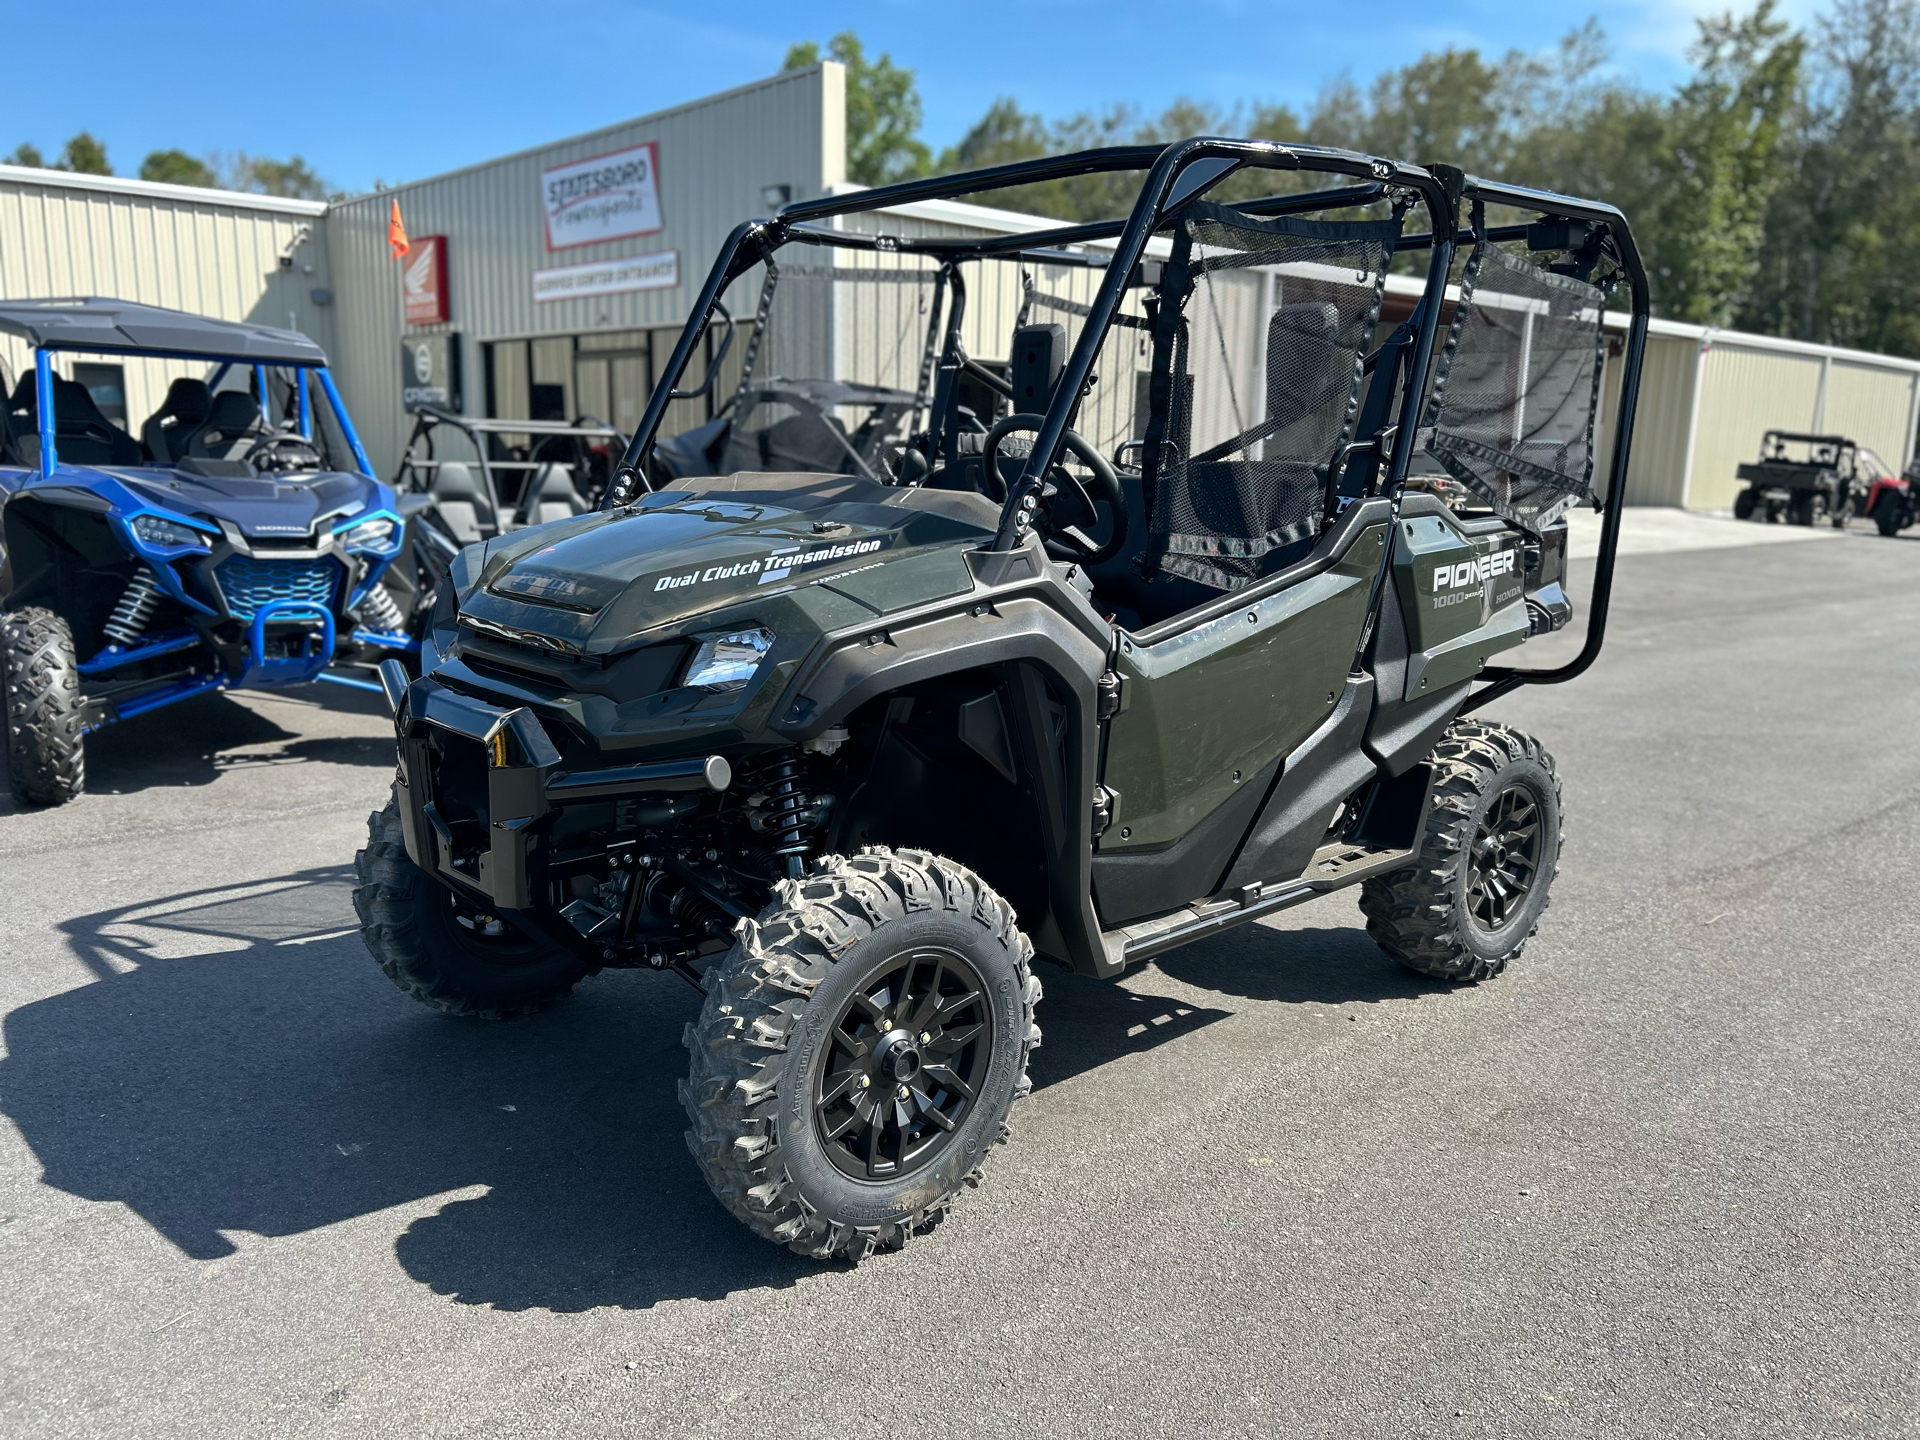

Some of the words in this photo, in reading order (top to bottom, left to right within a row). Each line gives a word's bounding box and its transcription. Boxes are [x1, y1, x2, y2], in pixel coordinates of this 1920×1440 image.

[548, 159, 647, 206] STATESBORO
[538, 274, 574, 293] SERVICE
[576, 269, 613, 286] CENTER
[617, 259, 674, 284] ENTRANCE
[653, 571, 700, 592] Dual
[702, 559, 760, 583] Clutch
[764, 539, 881, 571] Transmission
[1433, 549, 1515, 593] PIONEER
[518, 571, 577, 596] HONDA
[1433, 592, 1465, 609] 1000
[1495, 585, 1522, 605] HONDA
